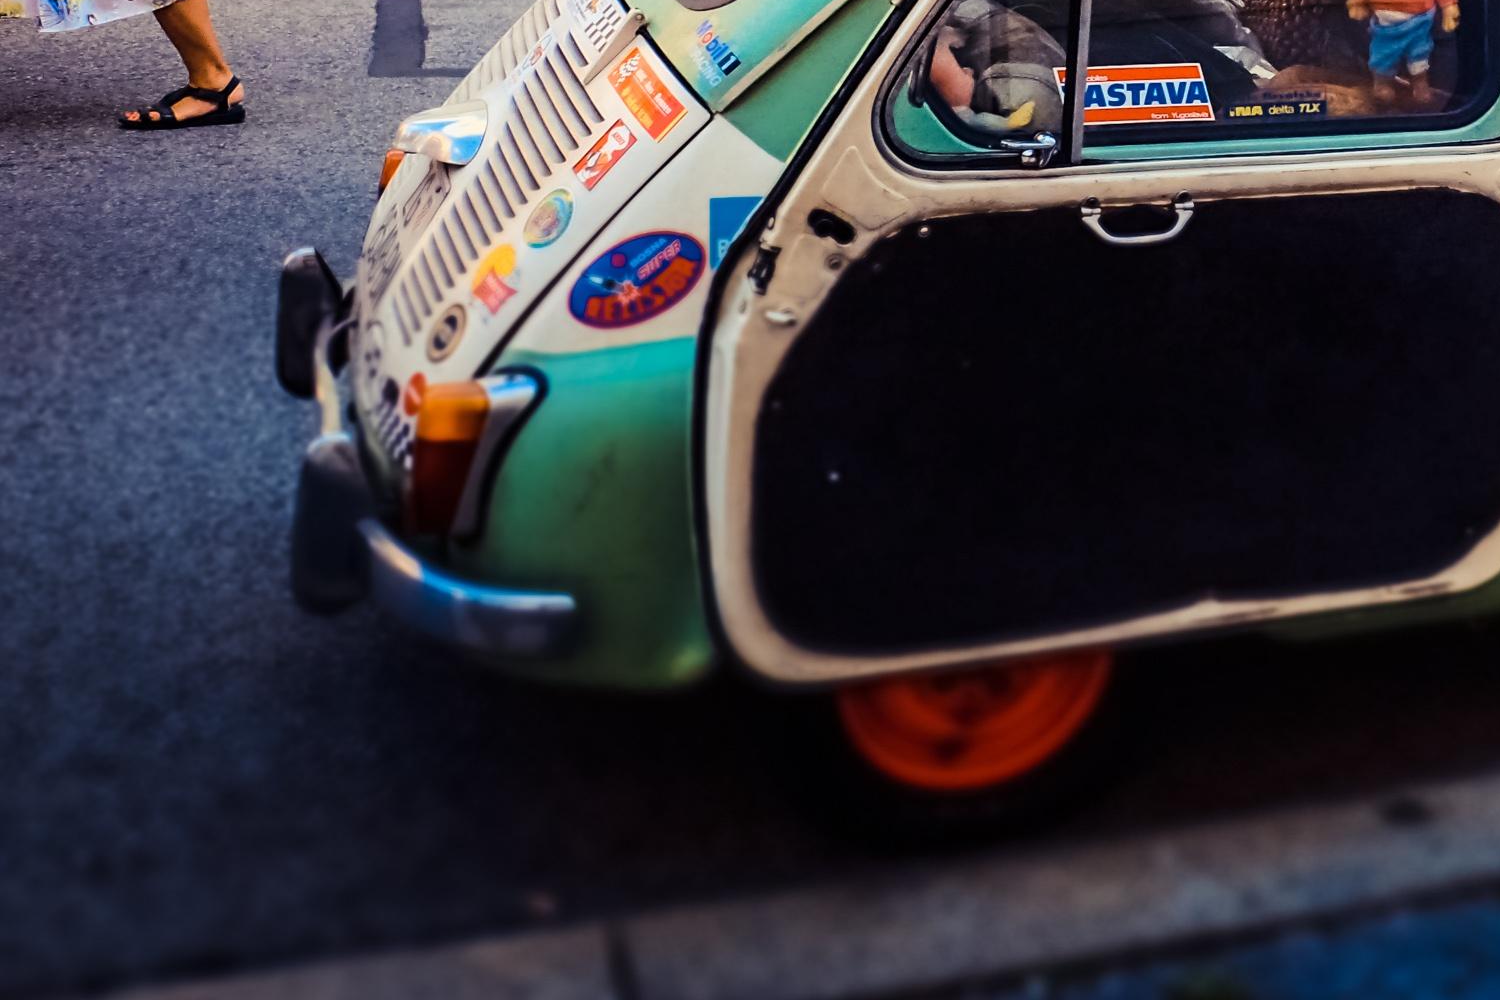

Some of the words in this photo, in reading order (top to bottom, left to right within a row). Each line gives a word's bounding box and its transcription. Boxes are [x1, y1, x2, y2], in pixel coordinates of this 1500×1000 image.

[696, 20, 729, 60] Mobil
[1062, 81, 1209, 108] ASTAVA
[1268, 105, 1295, 115] delta
[1299, 103, 1320, 113] TLX
